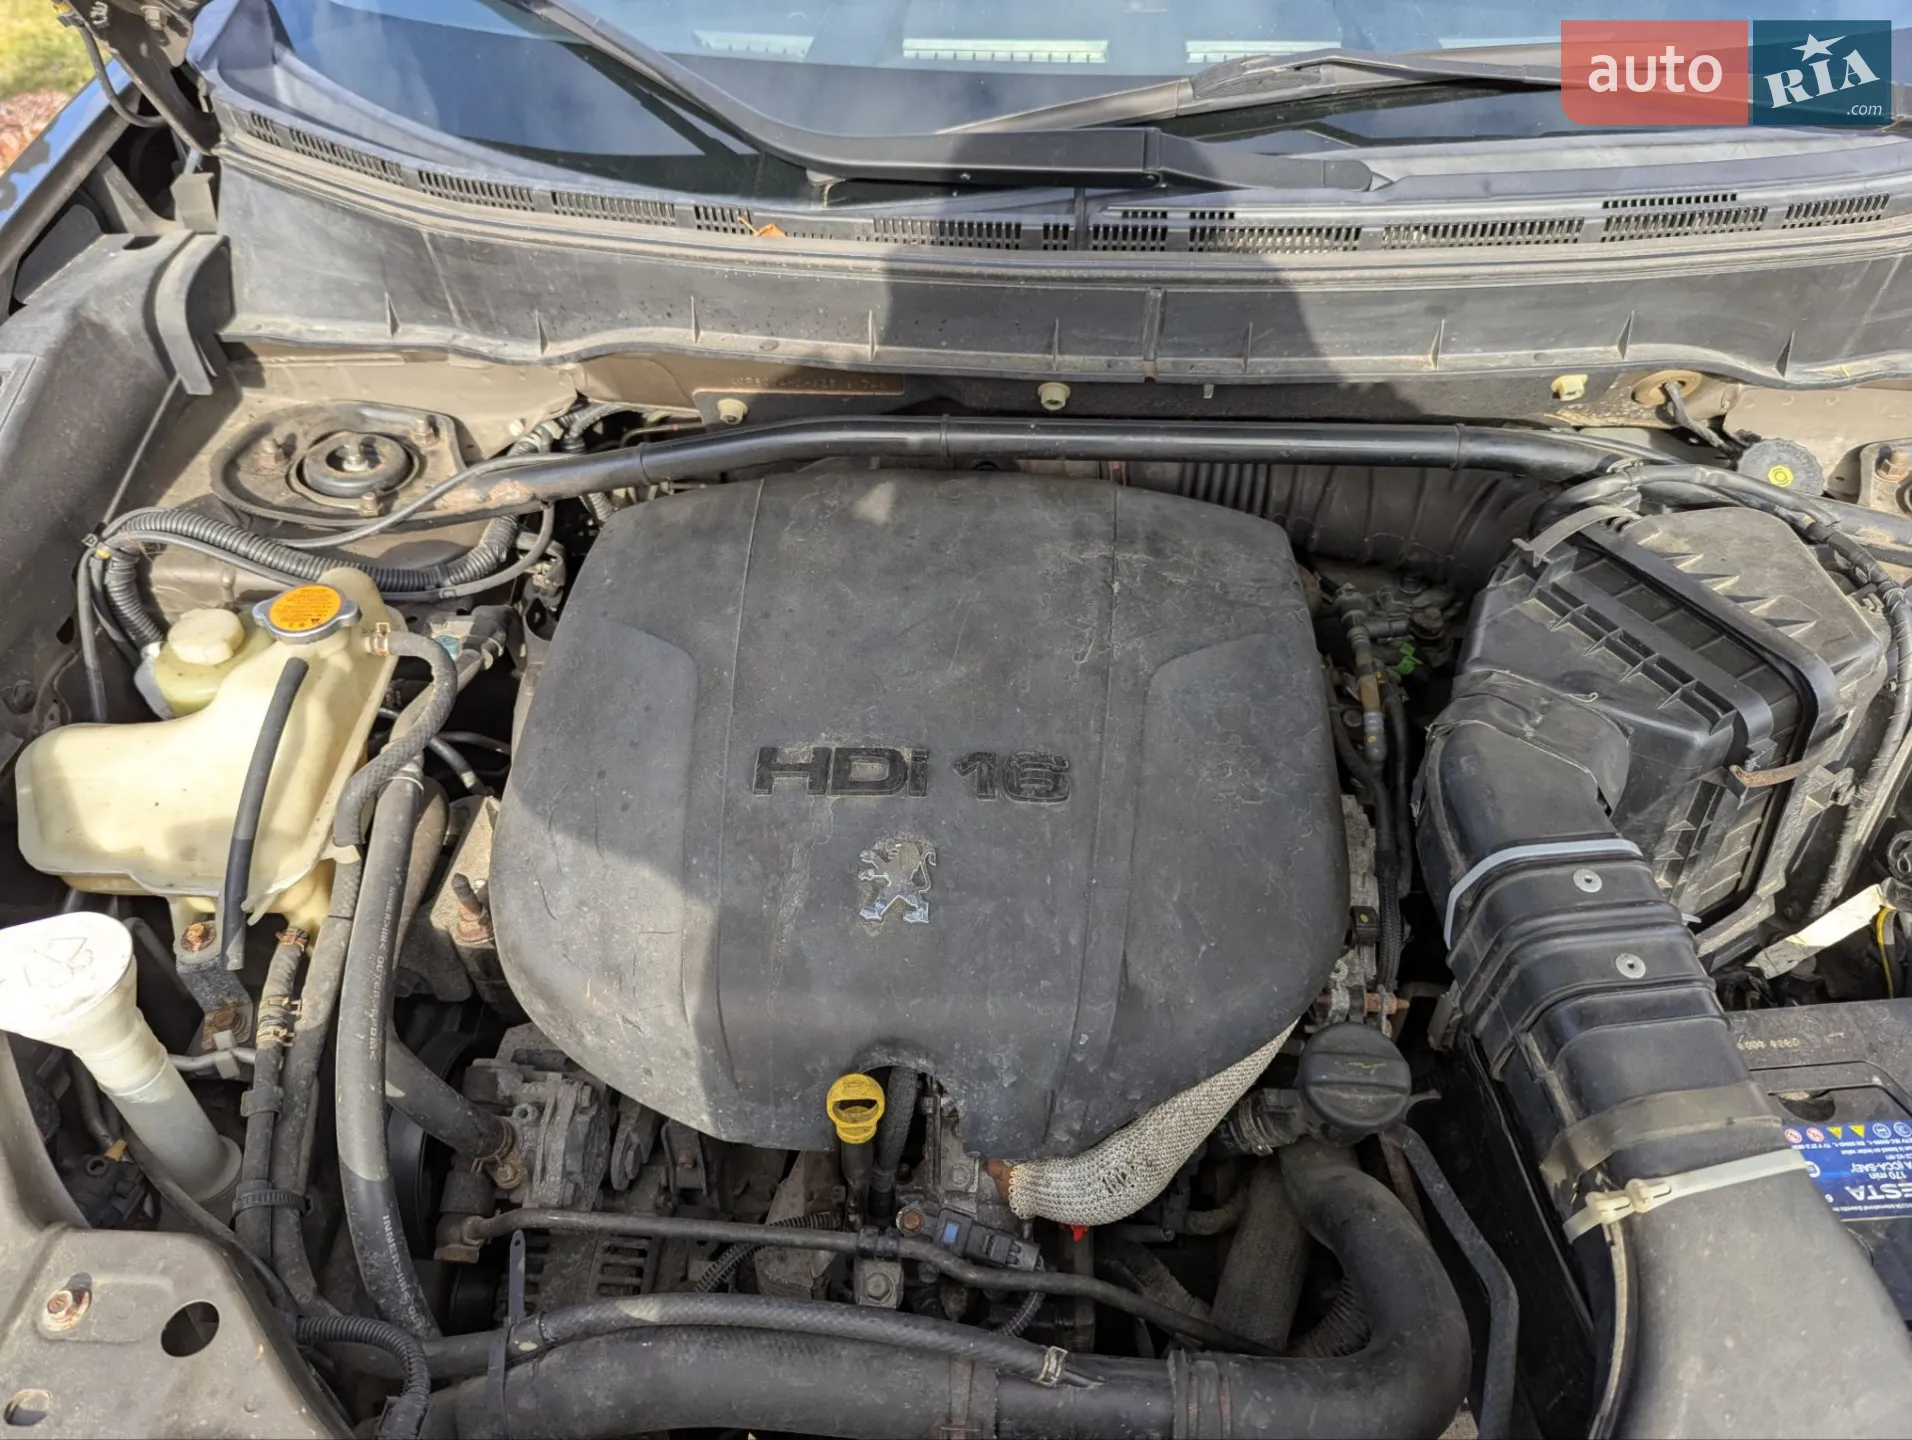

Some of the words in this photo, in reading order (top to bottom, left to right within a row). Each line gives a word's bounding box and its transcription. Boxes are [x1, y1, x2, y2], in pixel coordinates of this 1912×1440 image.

[752, 746, 929, 799] HDi
[952, 751, 1073, 805] 16
[1868, 1172, 1888, 1180] min
[1889, 1171, 1907, 1180] 170
